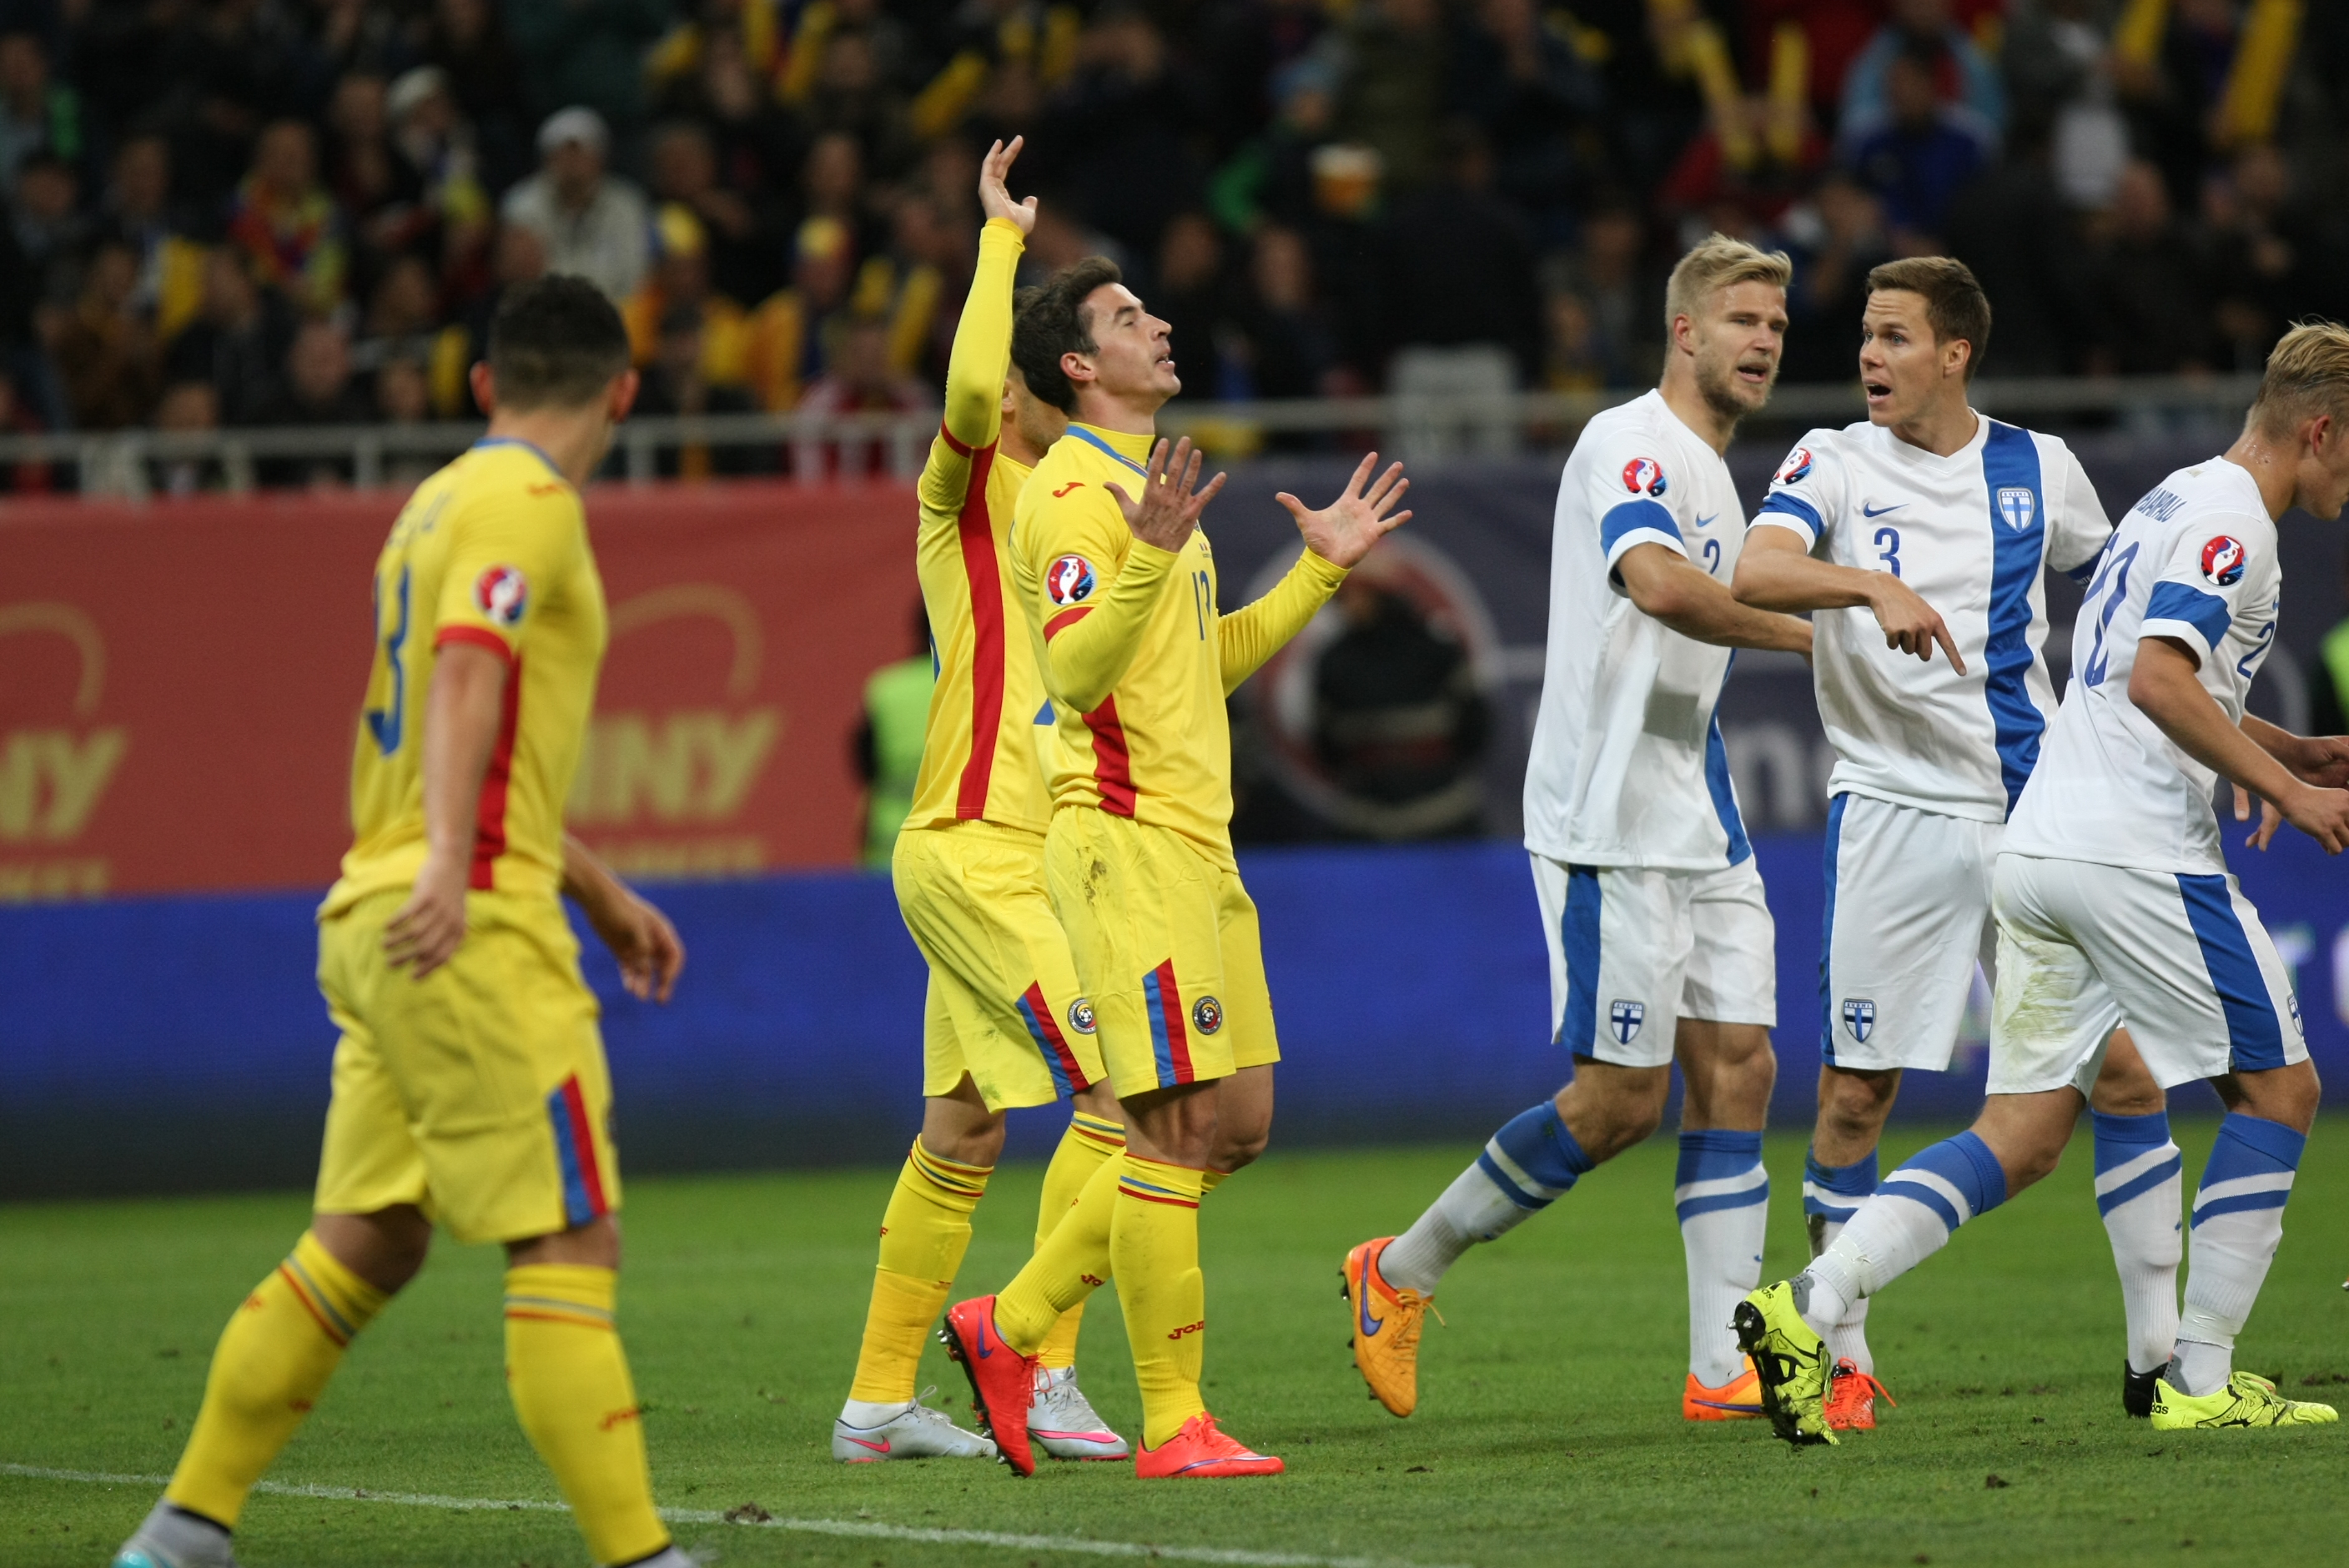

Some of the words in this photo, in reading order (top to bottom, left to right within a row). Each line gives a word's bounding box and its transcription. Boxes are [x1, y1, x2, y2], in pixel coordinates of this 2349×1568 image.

[1874, 526, 1900, 579] 3
[365, 561, 409, 756] 3
[2237, 621, 2276, 680] 2
